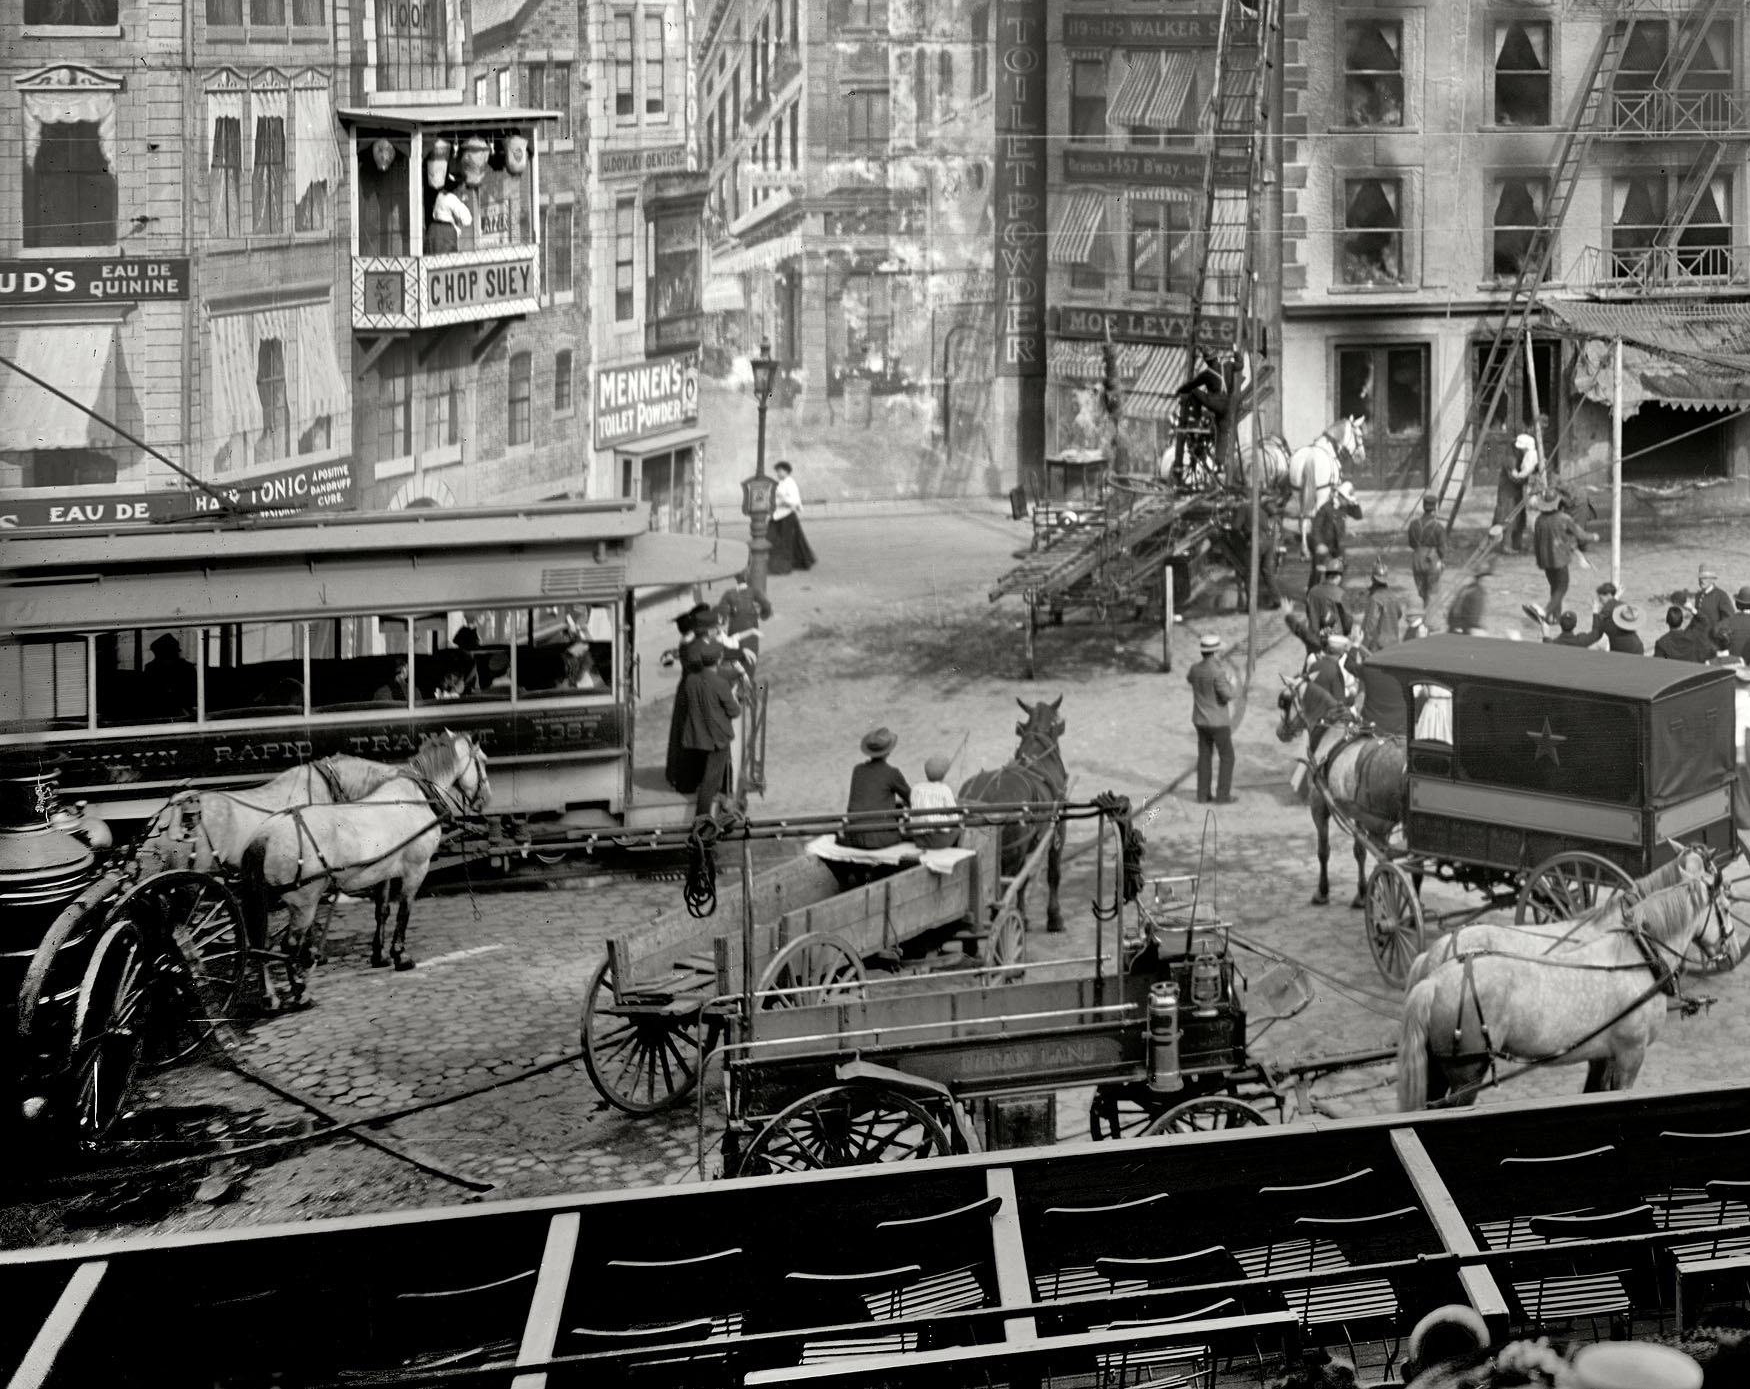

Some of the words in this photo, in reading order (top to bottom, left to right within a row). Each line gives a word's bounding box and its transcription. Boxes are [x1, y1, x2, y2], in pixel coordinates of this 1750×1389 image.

[1068, 21, 1089, 36] 119
[1102, 20, 1125, 36] 125
[1130, 21, 1201, 37] WALKER
[1108, 157, 1138, 173] 1457
[102, 264, 139, 278] EAU
[147, 264, 171, 277] DE
[89, 279, 179, 298] QUININE
[430, 269, 478, 306] CHOP
[485, 264, 531, 298] SUEY
[1069, 312, 1118, 333] MOE
[1127, 315, 1191, 338] LEVY
[1200, 319, 1214, 337] &
[600, 358, 682, 410] MENNEN'S
[599, 409, 634, 438] TOILET
[321, 464, 350, 481] POSITIVE
[310, 477, 352, 497] DANDRUFF
[49, 504, 104, 523] EAU
[115, 502, 150, 520] DE
